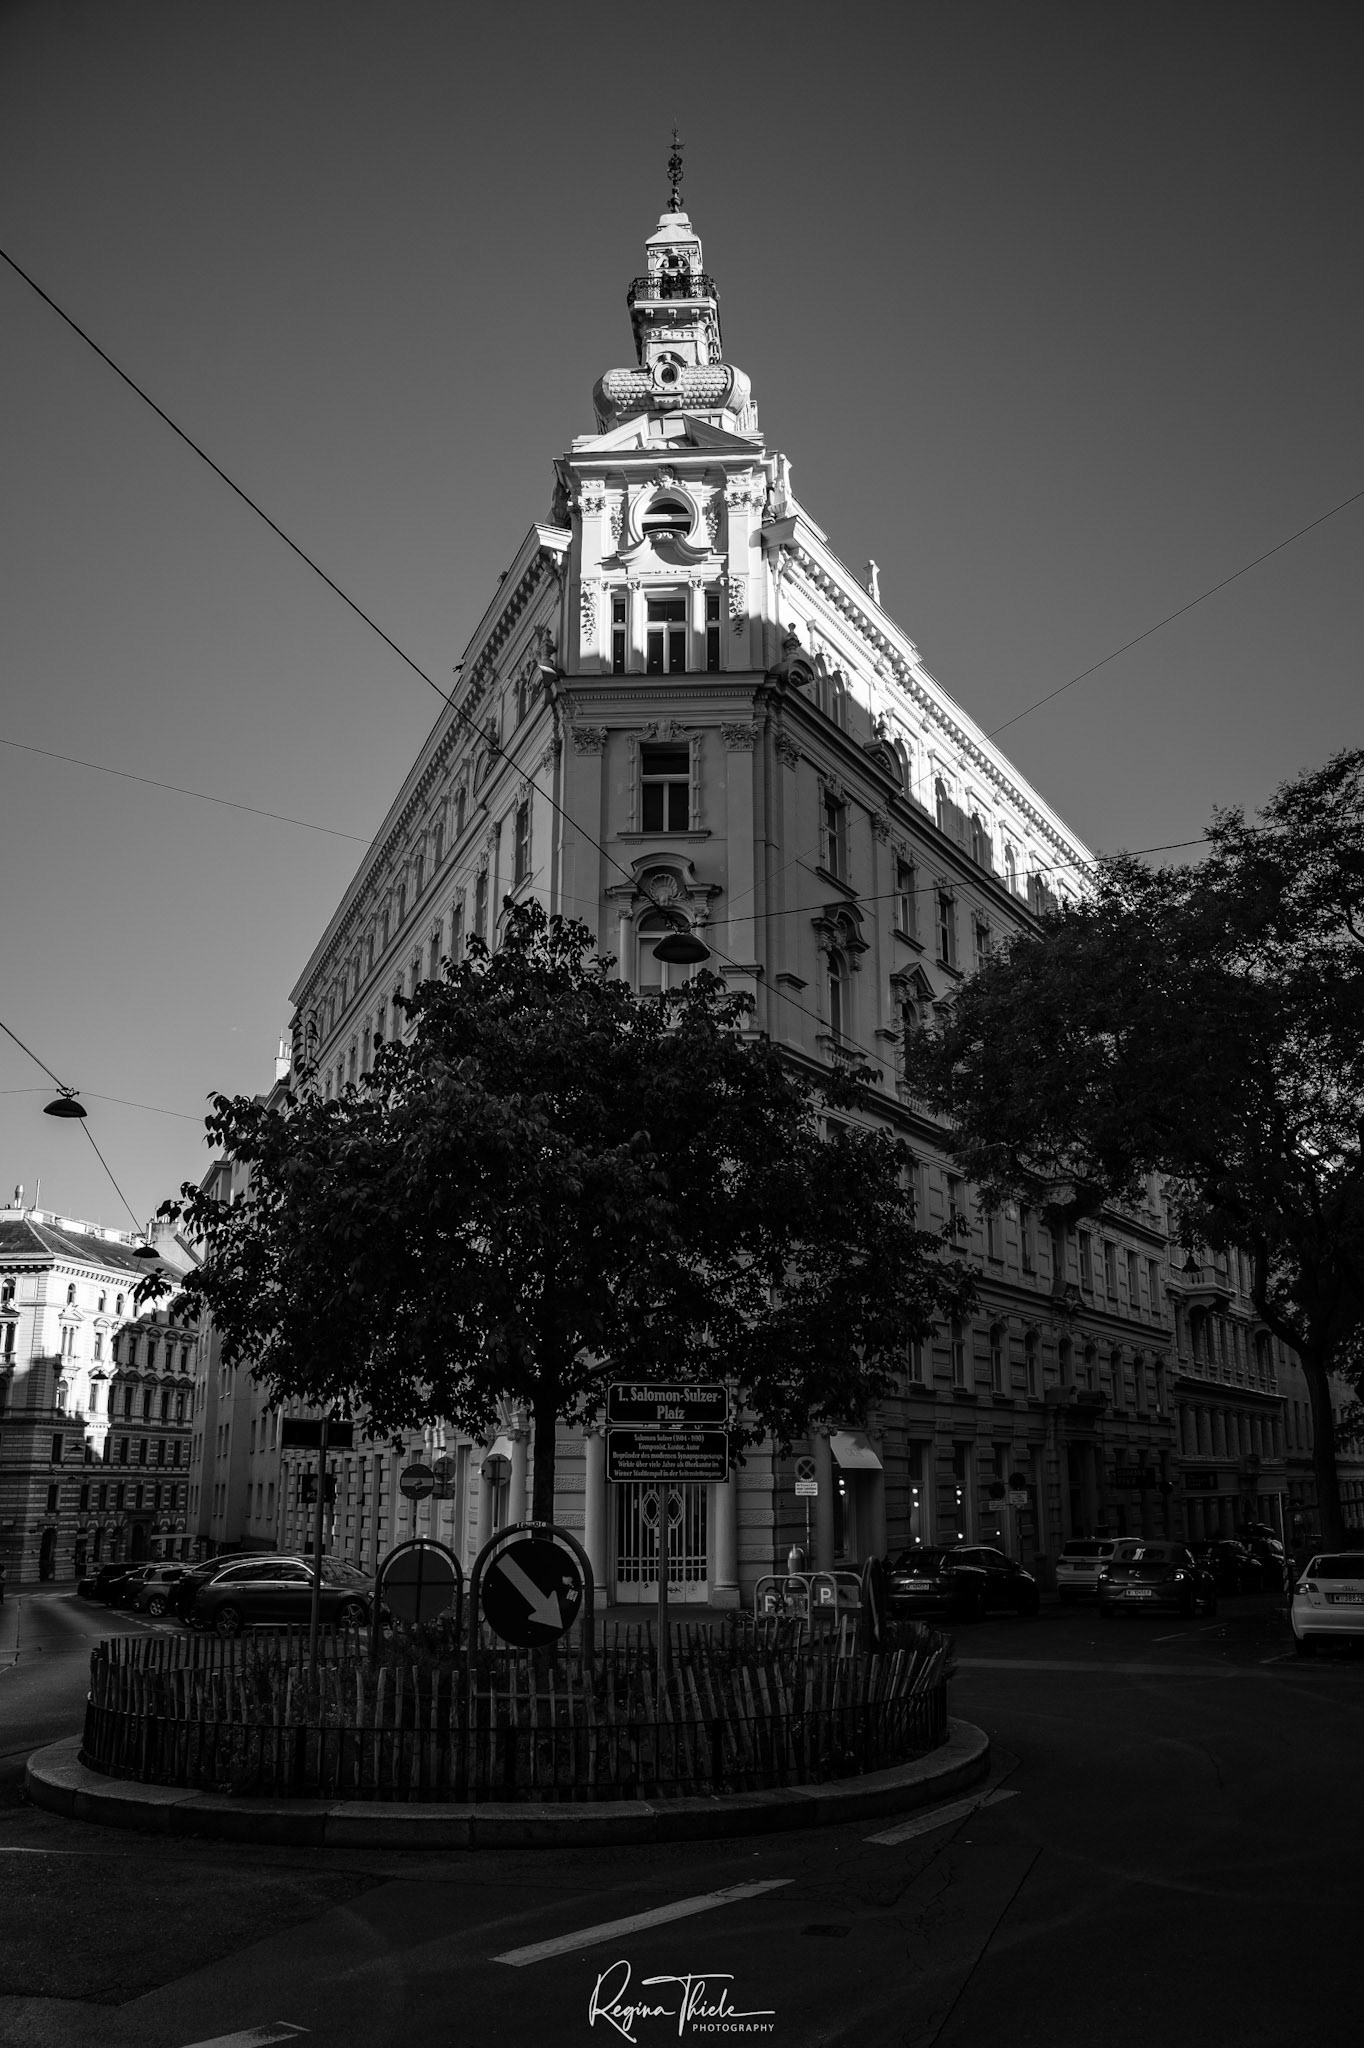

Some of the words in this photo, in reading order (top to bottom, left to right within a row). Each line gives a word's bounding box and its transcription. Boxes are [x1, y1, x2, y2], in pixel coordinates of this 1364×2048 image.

[630, 1387, 722, 1403] Salomon-Sulzer-
[656, 1405, 686, 1420] Platz
[820, 1587, 832, 1604] P
